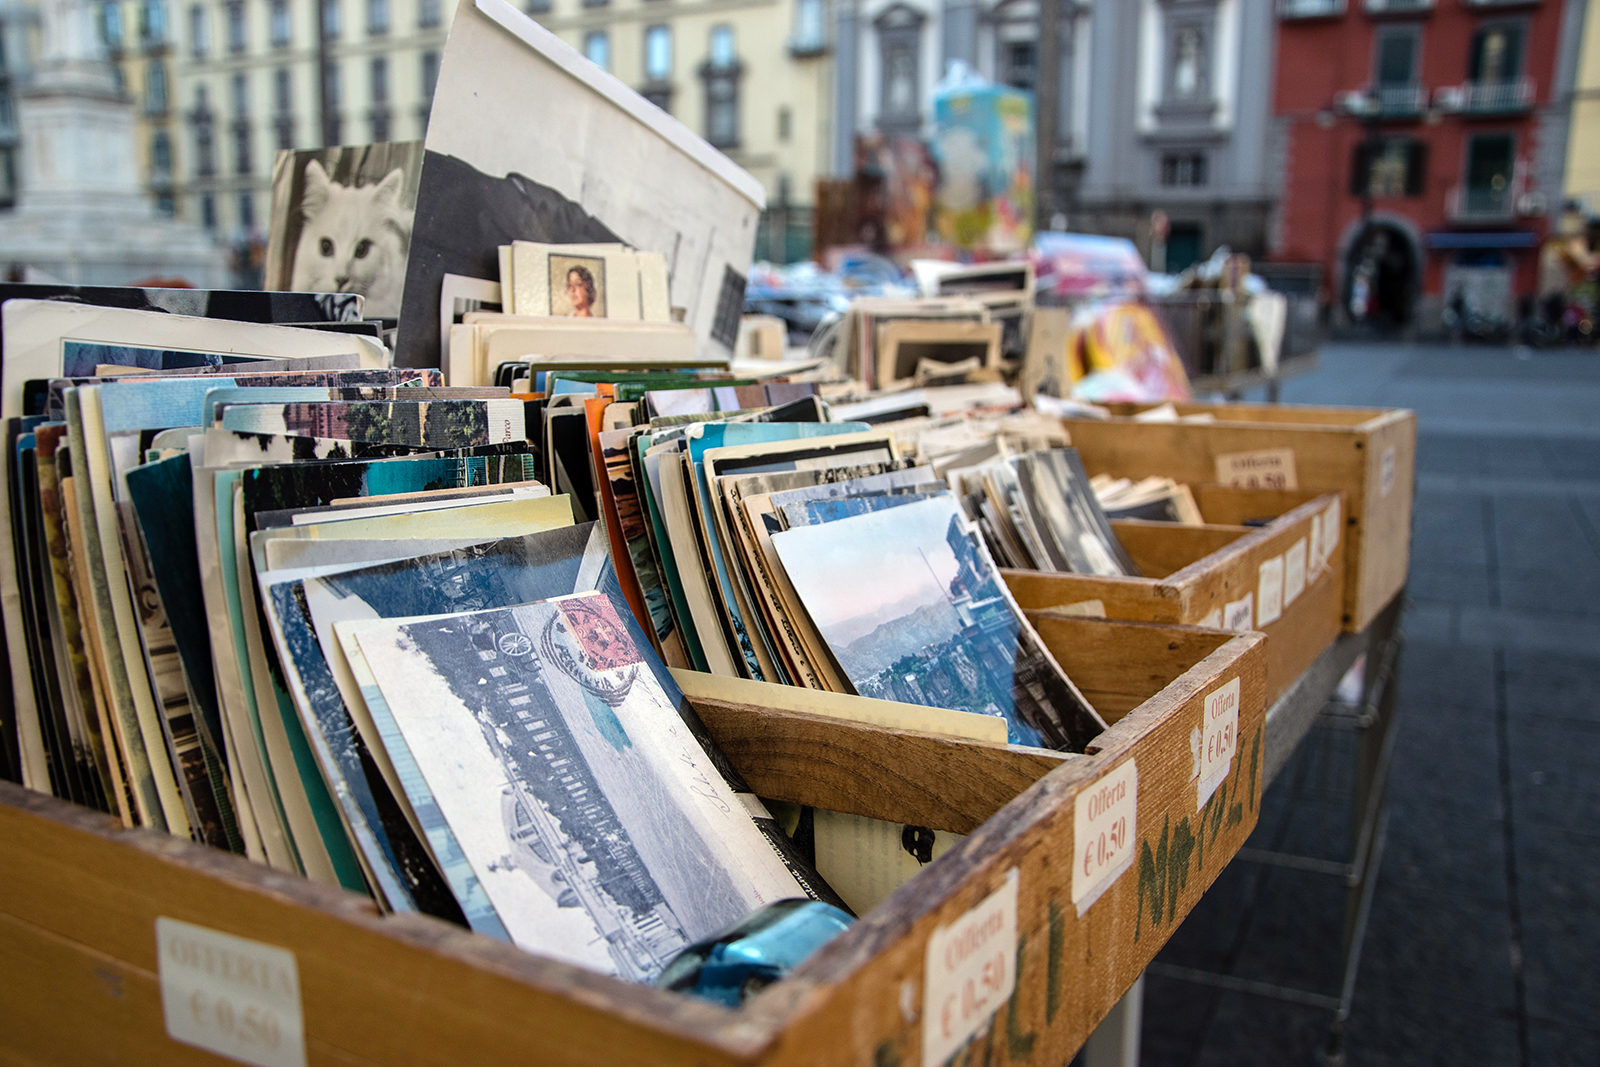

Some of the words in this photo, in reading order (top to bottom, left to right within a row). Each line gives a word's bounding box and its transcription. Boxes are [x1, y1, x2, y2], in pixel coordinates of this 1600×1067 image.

[1211, 692, 1235, 720] Offerta
[1088, 780, 1127, 822] Offerta
[1083, 840, 1094, 877] €
